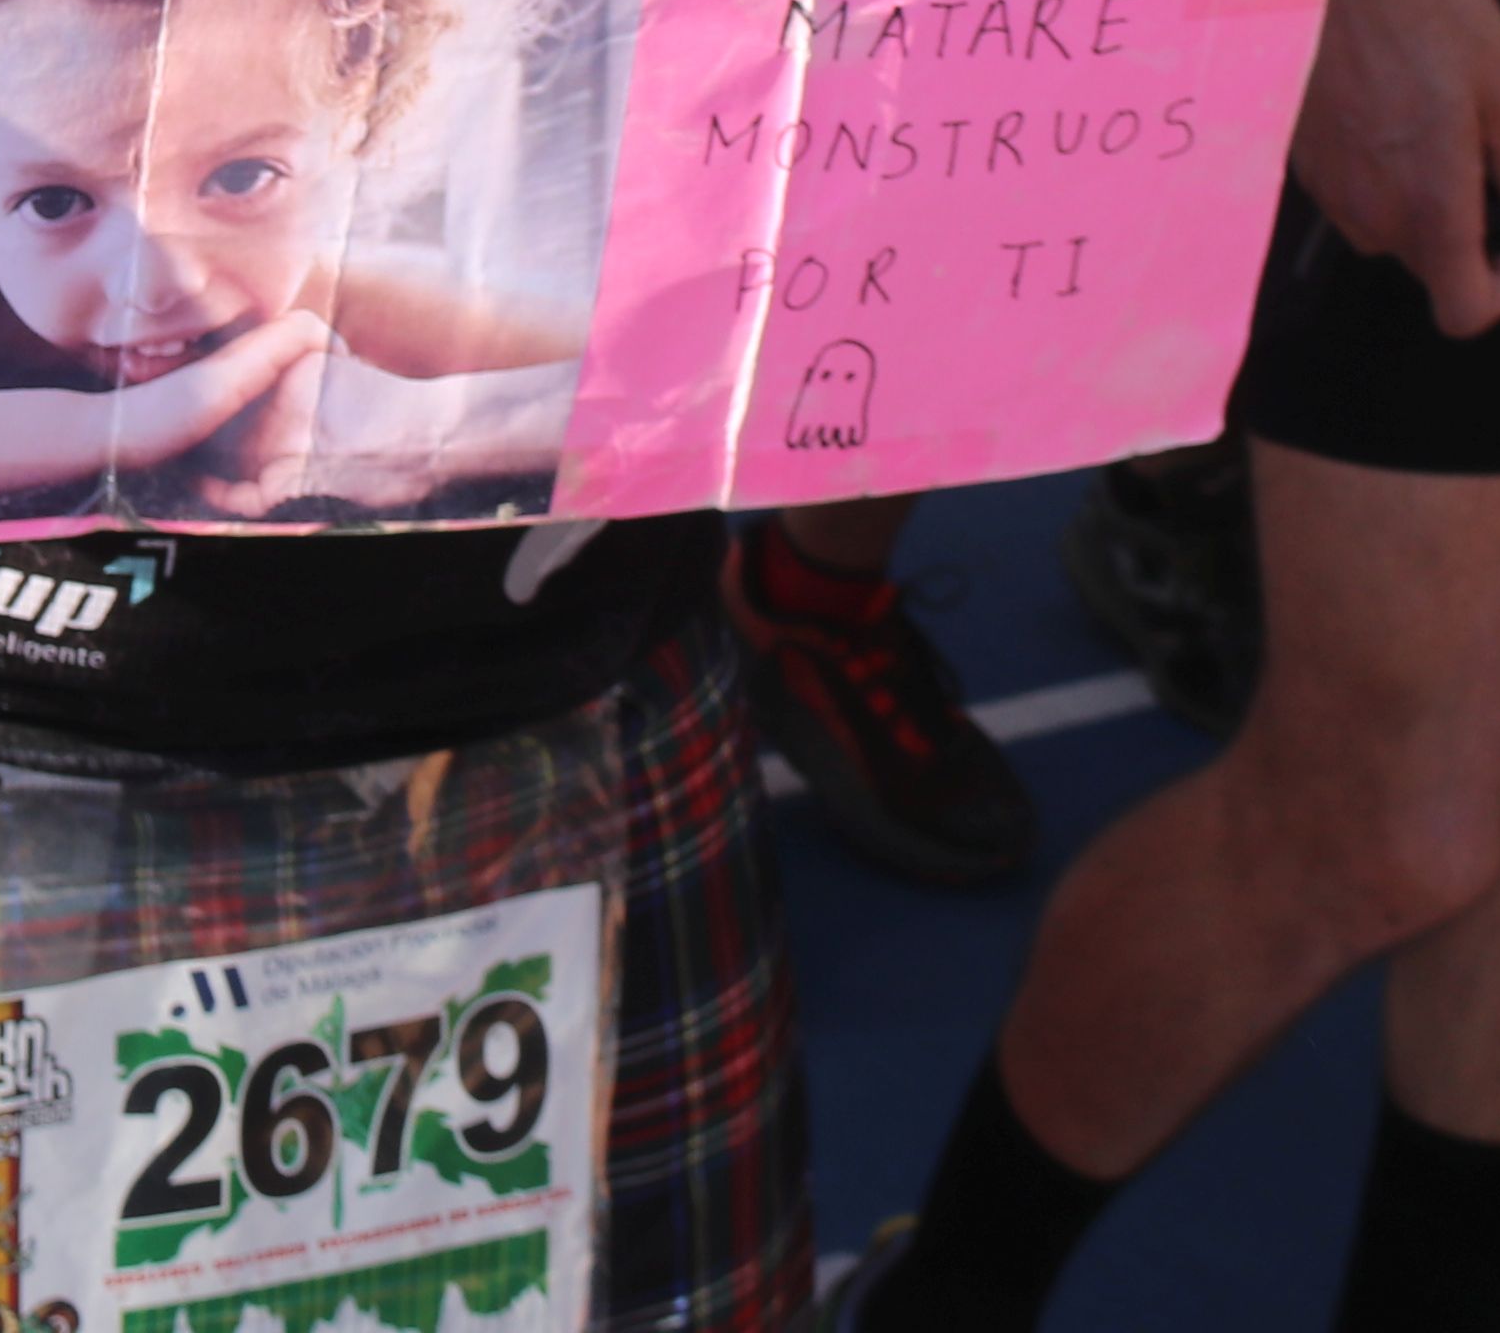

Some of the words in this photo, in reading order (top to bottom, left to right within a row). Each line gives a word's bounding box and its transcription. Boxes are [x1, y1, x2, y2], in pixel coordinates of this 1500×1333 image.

[704, 97, 1196, 181] MONSTRUOS
[735, 245, 898, 313] POR
[1000, 236, 1090, 300] TI
[121, 999, 551, 1222] 2679
